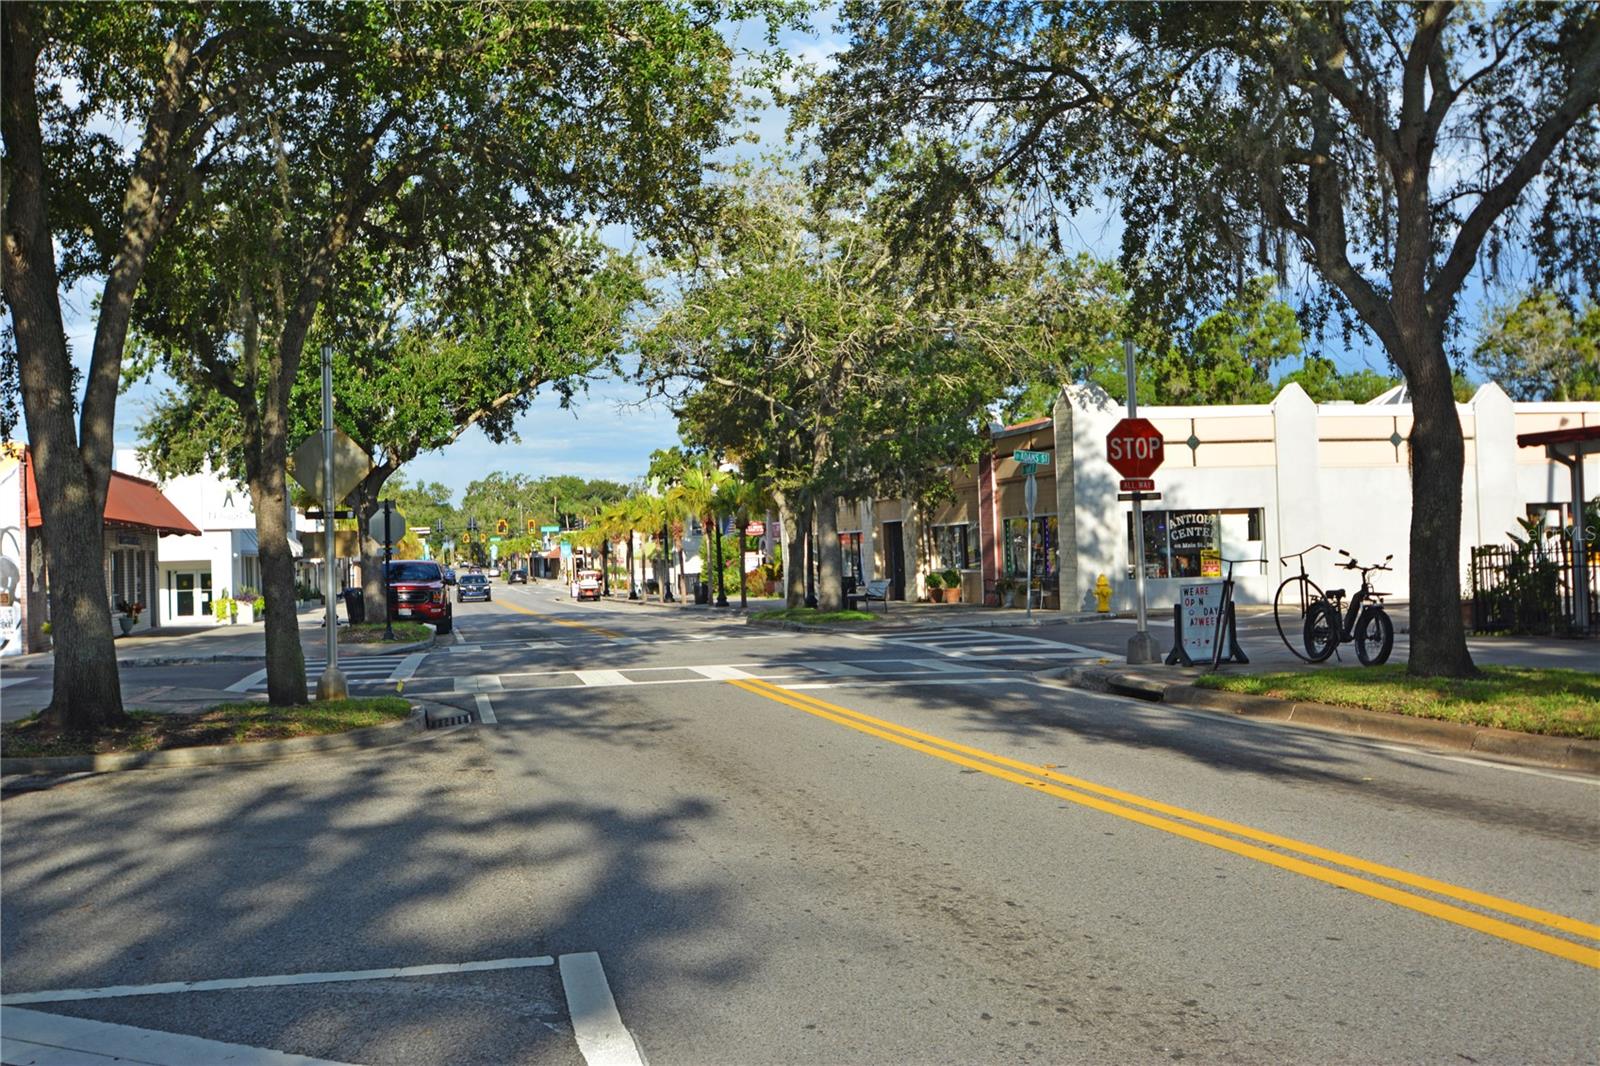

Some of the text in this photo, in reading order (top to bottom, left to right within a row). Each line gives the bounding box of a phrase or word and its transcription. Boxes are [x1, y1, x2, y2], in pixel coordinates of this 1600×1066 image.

[1110, 437, 1160, 460] STOP
[1123, 481, 1153, 489] ALL WAY
